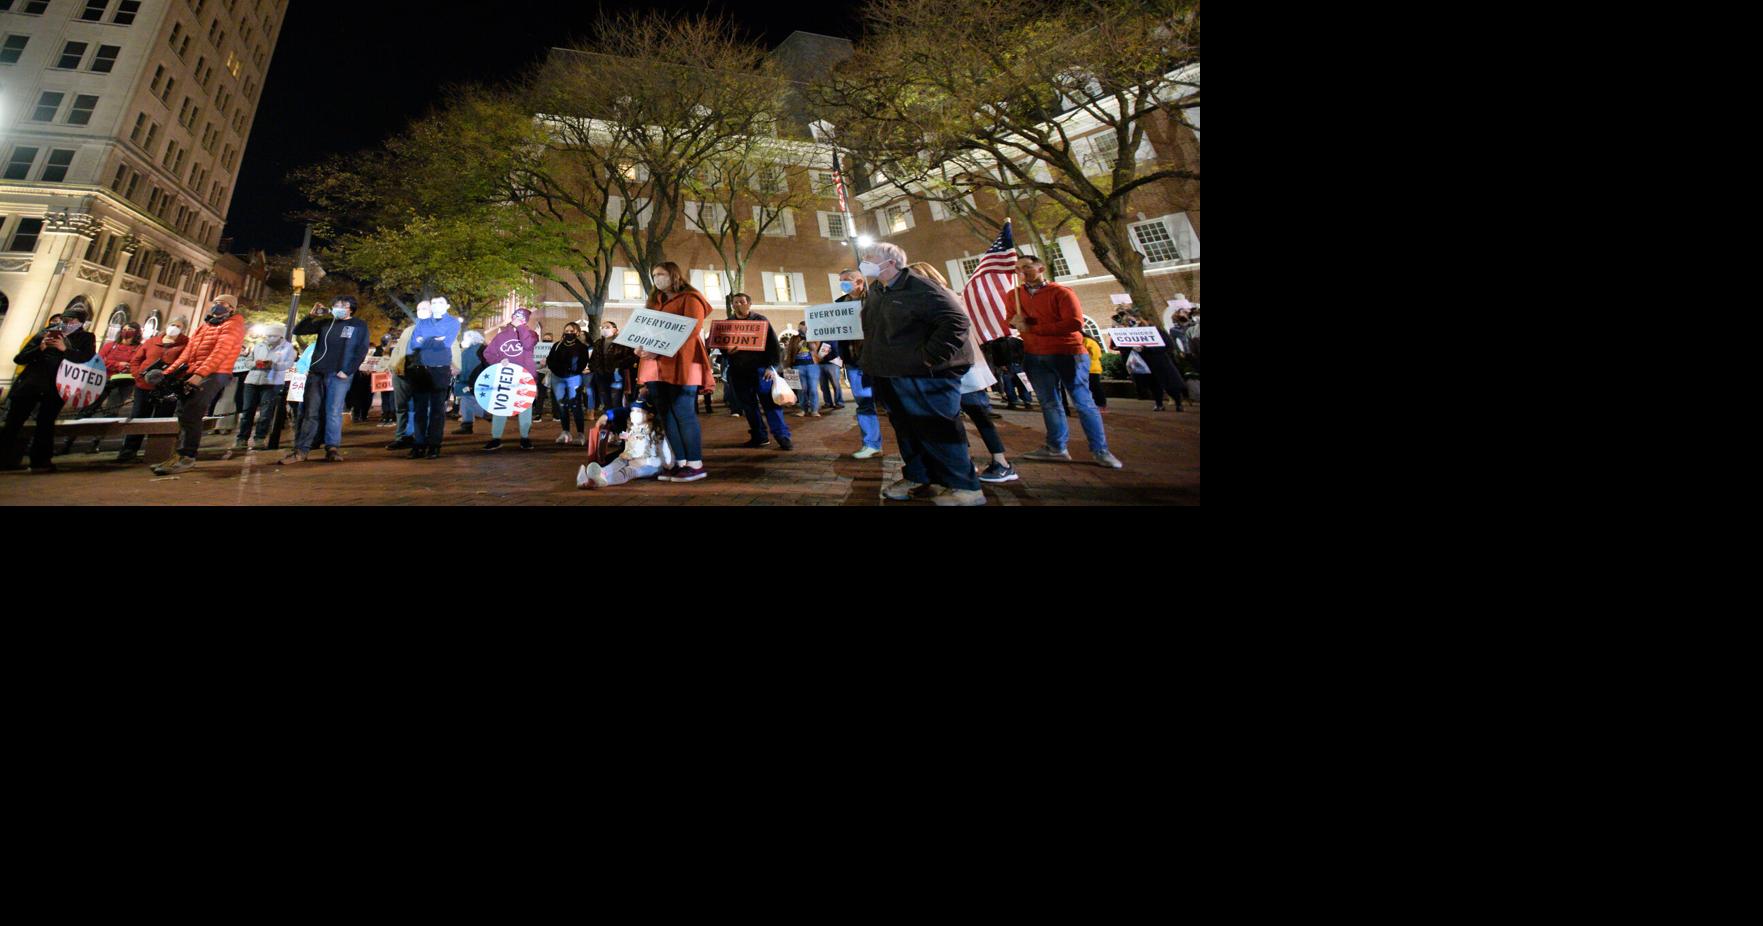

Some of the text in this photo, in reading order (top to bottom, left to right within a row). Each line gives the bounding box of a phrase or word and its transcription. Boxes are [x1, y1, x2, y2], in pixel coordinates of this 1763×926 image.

[809, 308, 855, 319] EVERYONE
[634, 315, 687, 332] EVERYONE
[813, 326, 853, 336] COUNTS!
[627, 334, 671, 350] COUNTS!
[713, 336, 760, 345] COUNT
[64, 364, 104, 386] VOTED
[493, 366, 515, 410] VOTED
